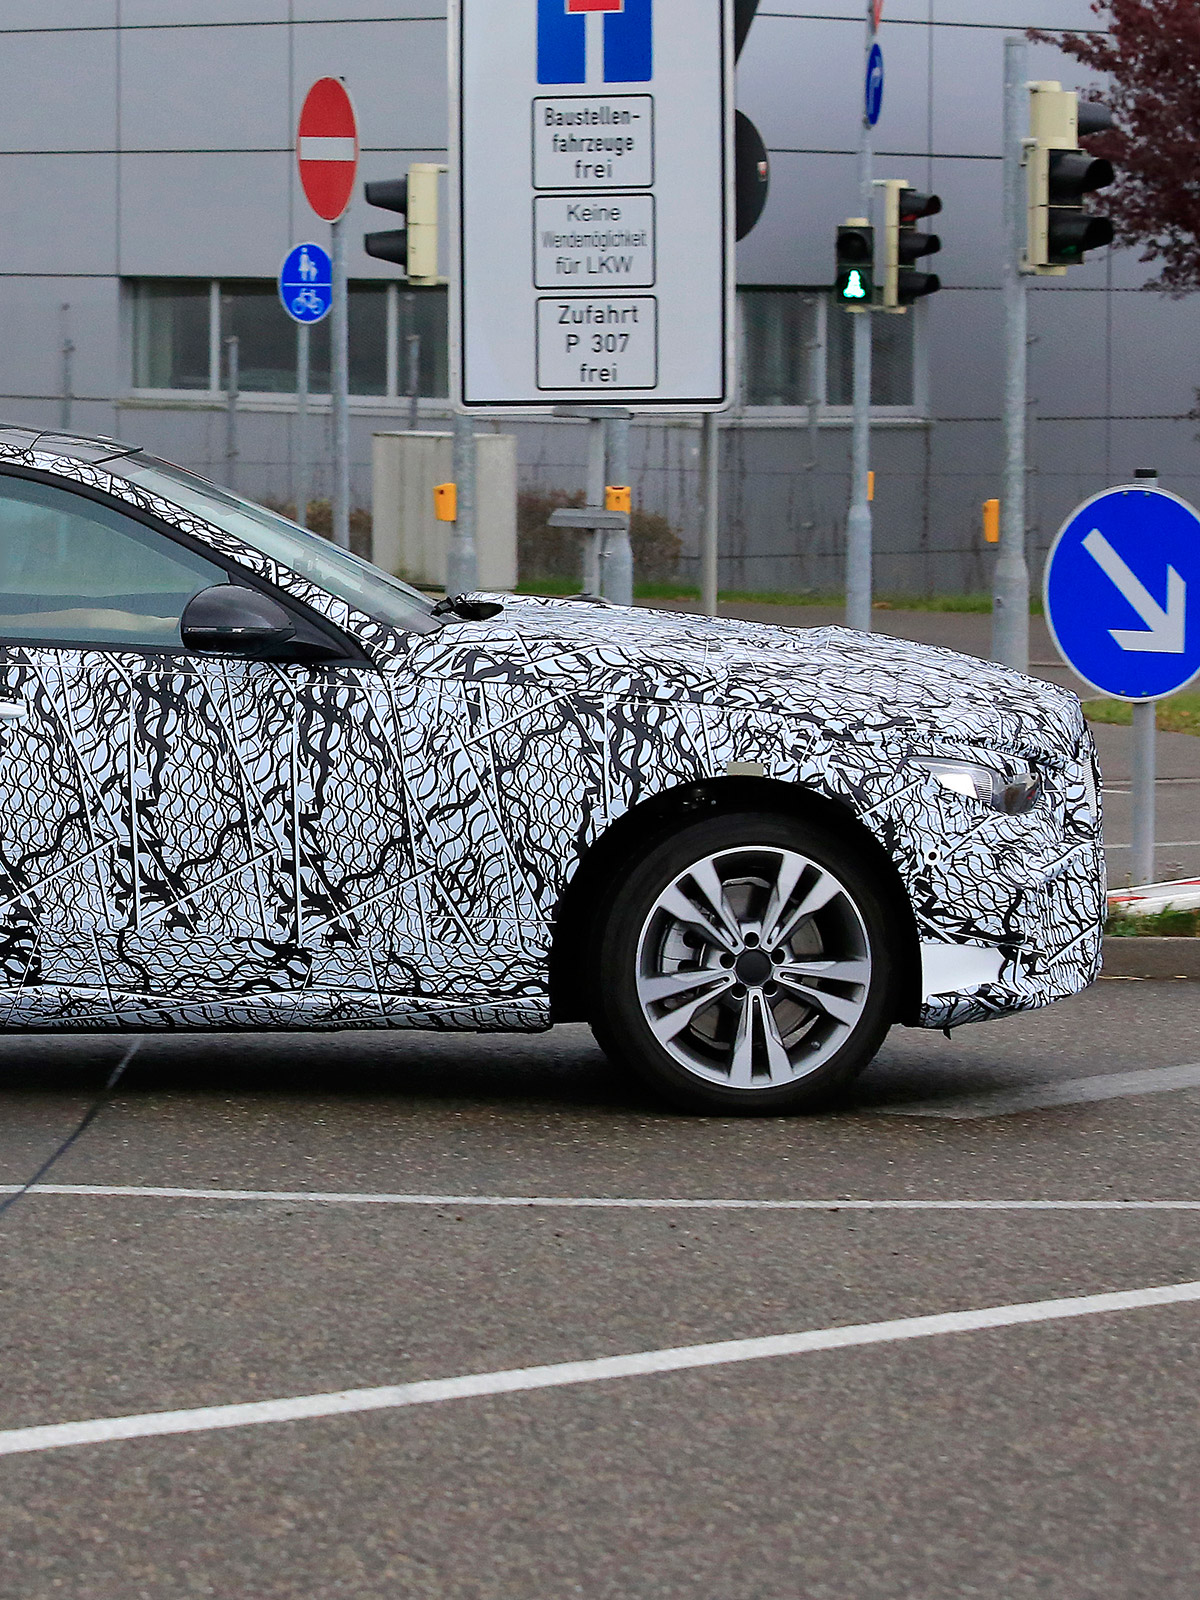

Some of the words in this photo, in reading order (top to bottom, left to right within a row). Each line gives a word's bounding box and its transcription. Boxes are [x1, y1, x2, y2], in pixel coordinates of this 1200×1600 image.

[544, 106, 640, 126] Baustellen-
[553, 133, 635, 156] fahrzeuge
[576, 160, 613, 178] frei
[566, 204, 621, 222] Keine
[556, 257, 581, 274] für
[586, 256, 633, 274] LKW
[558, 305, 639, 324] Zufahrt
[566, 334, 579, 353] P
[591, 333, 630, 353] 307
[580, 363, 617, 382] frei
